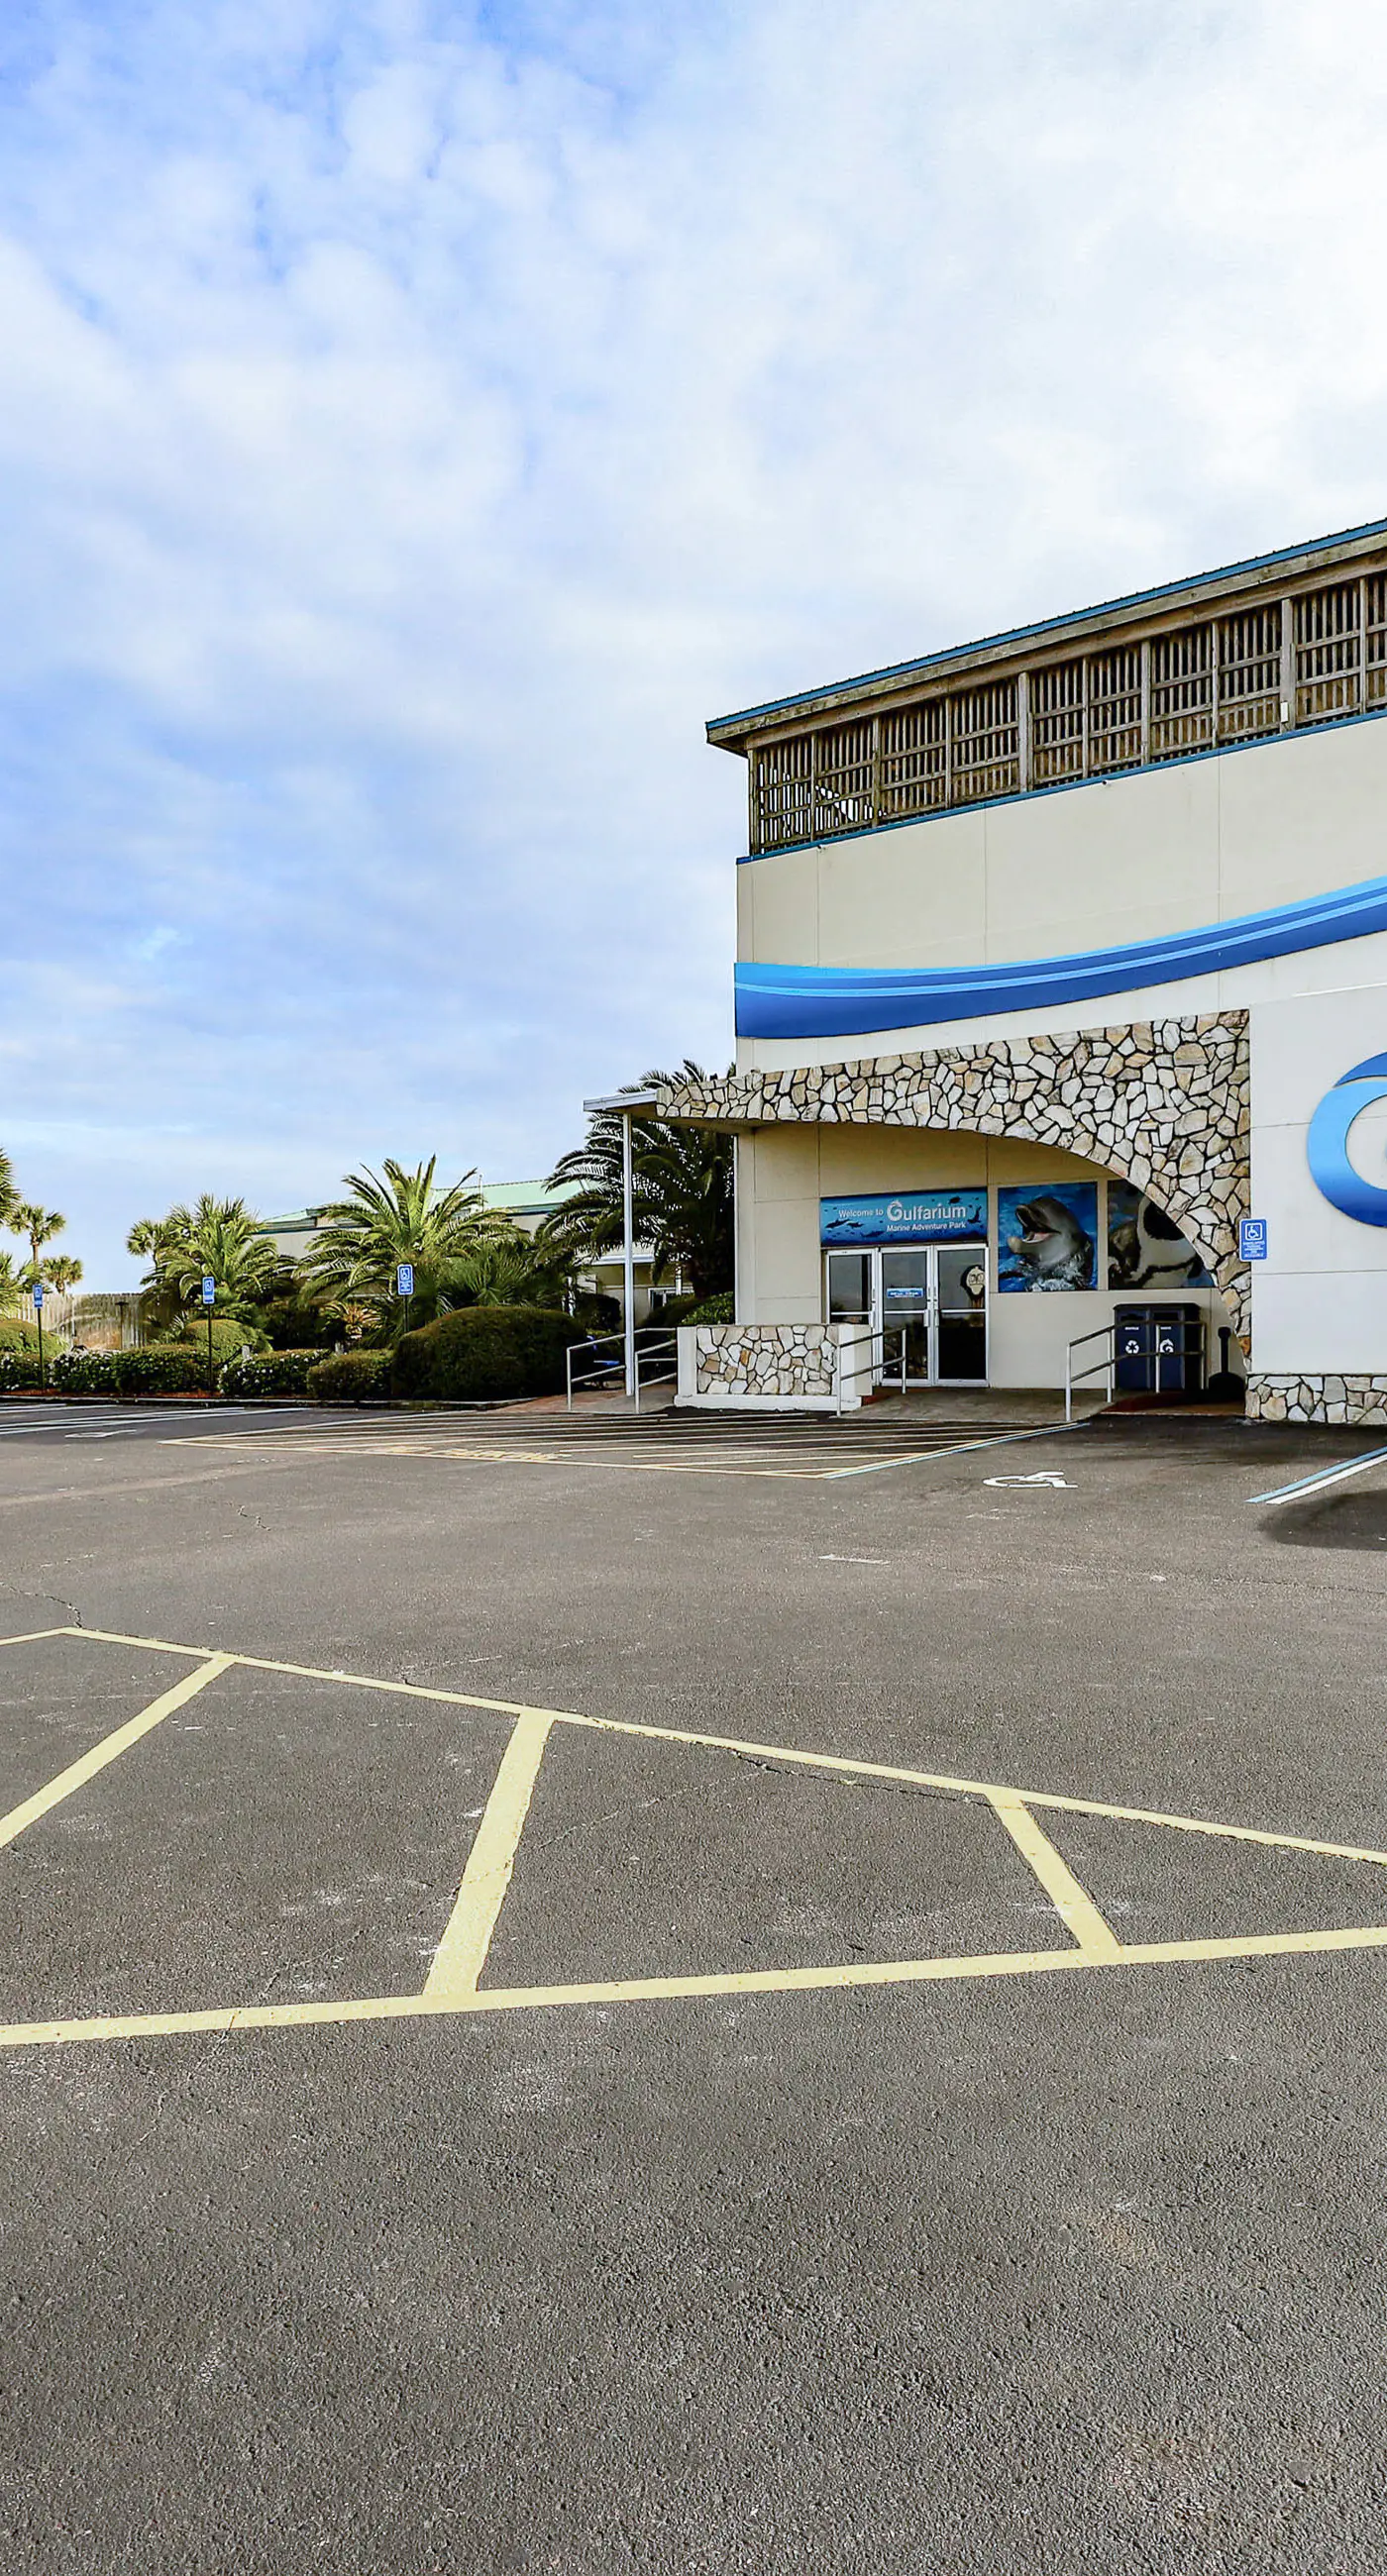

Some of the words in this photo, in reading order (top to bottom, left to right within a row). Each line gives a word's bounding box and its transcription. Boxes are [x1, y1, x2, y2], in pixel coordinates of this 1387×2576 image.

[838, 1208, 874, 1217] Welcome
[887, 1200, 967, 1221] Gulfarium
[911, 1222, 948, 1231] Adventure
